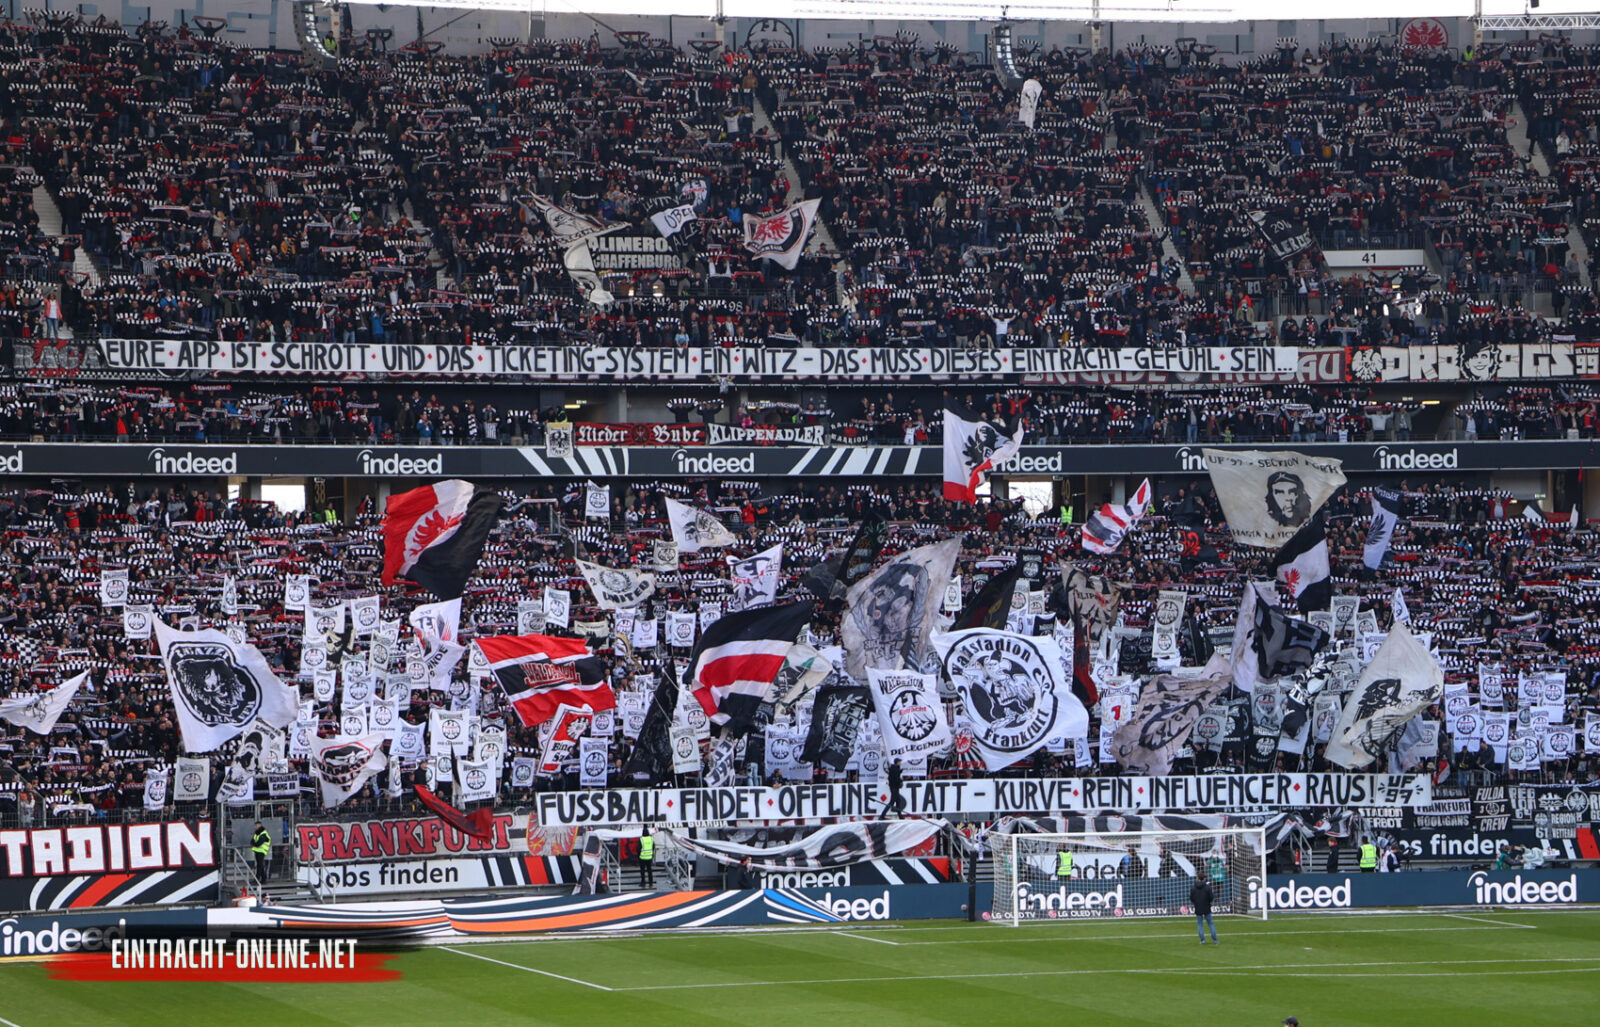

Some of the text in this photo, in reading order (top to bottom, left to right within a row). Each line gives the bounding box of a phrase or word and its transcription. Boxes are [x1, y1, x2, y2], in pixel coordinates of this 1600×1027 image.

[588, 236, 672, 252] ALIMERO
[592, 254, 682, 269] CHAFFENBURG
[1361, 252, 1378, 264] 41
[106, 340, 165, 369] EURE
[177, 341, 219, 367] APP
[231, 342, 261, 368] IST
[271, 343, 366, 370] SCHROTT
[382, 345, 425, 371] UND
[436, 345, 474, 372] DAS
[487, 347, 689, 374] TICKETING-SYSTEM
[702, 348, 740, 373] EIN
[742, 348, 797, 373] WITZ
[820, 349, 859, 374] DAS
[871, 349, 920, 374] MUSS
[930, 348, 1000, 373] DIESES
[1576, 354, 1599, 374] 99
[579, 426, 628, 443] Nieder
[708, 423, 825, 446] KLIPPENADLER
[154, 450, 237, 473] indeed
[362, 450, 442, 474] indeed
[677, 450, 755, 473] indeed
[1258, 458, 1300, 468] SECTION
[1379, 446, 1458, 470] indeed
[951, 637, 1032, 676] Waldstadion
[983, 708, 1050, 748] Frankfurt
[1387, 775, 1416, 788] UF
[540, 791, 666, 822] FUSSBALL
[680, 788, 767, 818] FINDET
[778, 784, 877, 817] OFFLINE
[998, 780, 1071, 811] KURVE
[1150, 774, 1292, 807] INFLUENCER
[1305, 774, 1374, 805] RAUS!
[1384, 789, 1414, 804] 97
[1476, 787, 1504, 800] FULDA
[1480, 816, 1509, 832] CREW
[297, 814, 513, 862] FRANKFUT
[380, 863, 459, 885] finden
[1012, 882, 1123, 911] indeed
[1247, 876, 1352, 908] indeed
[1473, 872, 1578, 905] indeed
[820, 890, 891, 920] deed
[1090, 909, 1102, 917] TV
[1123, 907, 1167, 916] LG OLED TV
